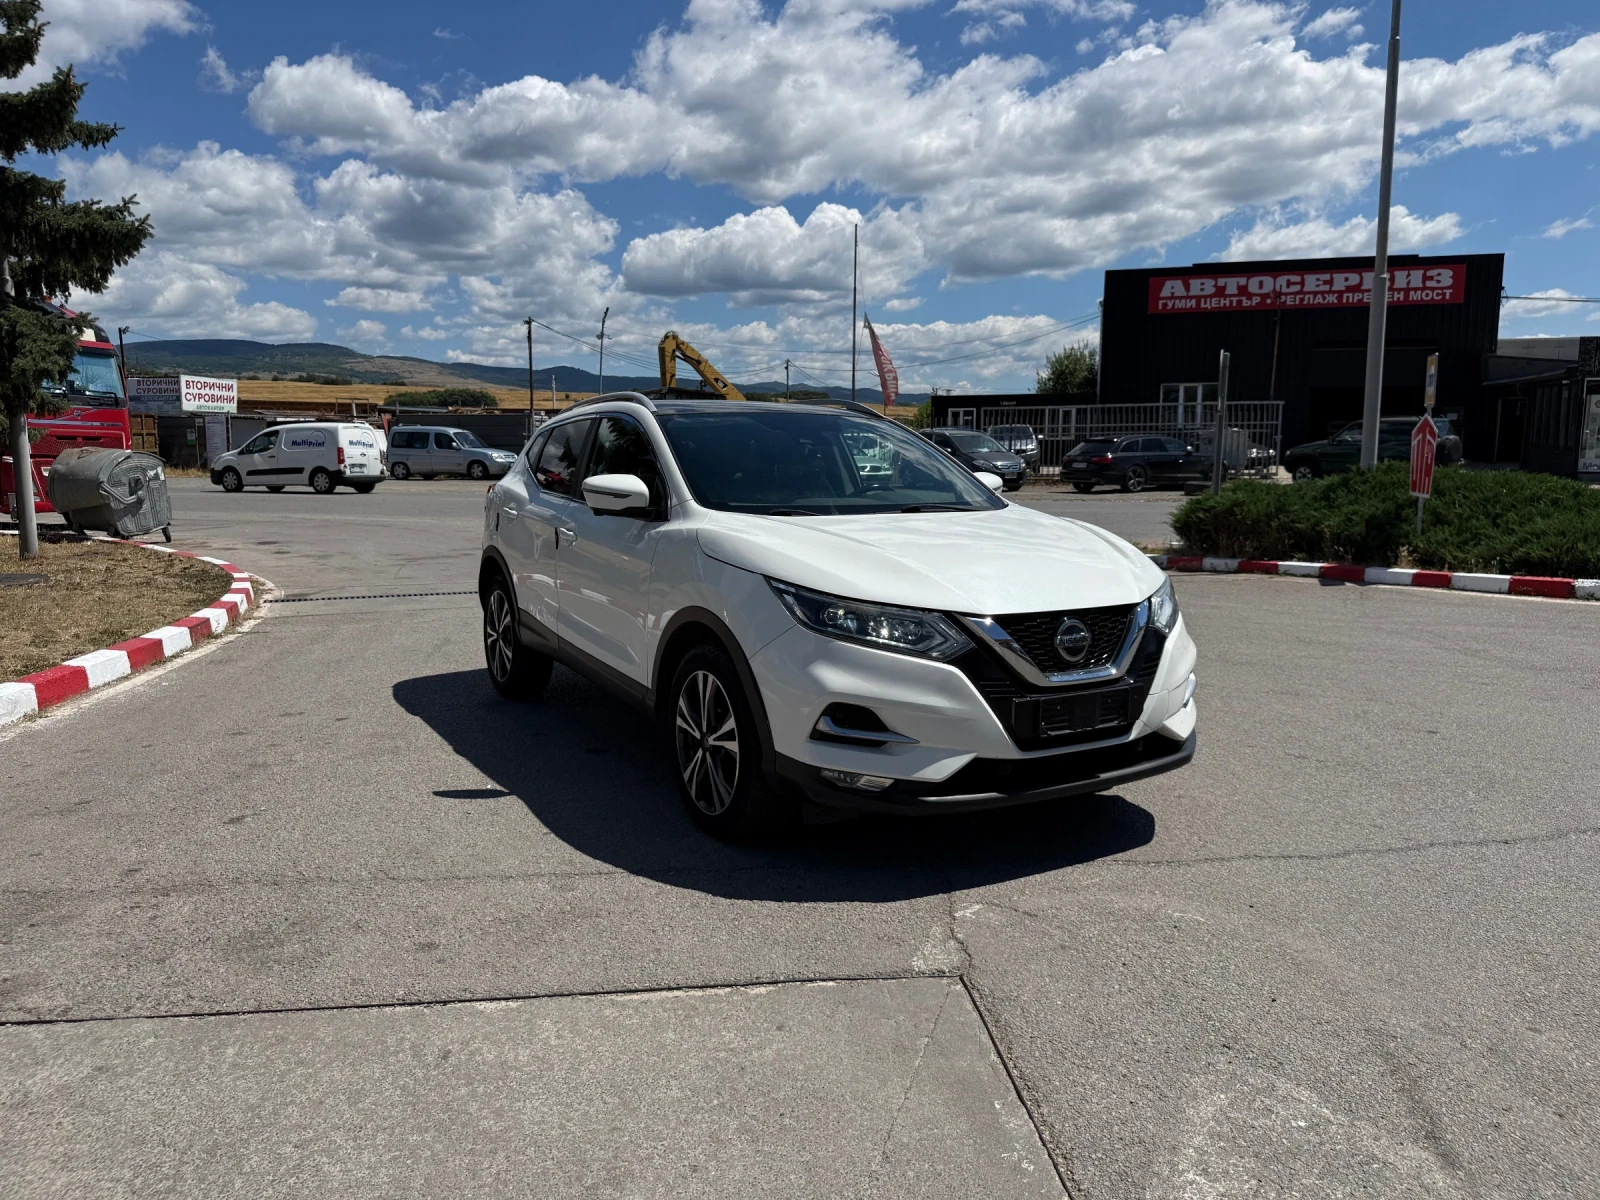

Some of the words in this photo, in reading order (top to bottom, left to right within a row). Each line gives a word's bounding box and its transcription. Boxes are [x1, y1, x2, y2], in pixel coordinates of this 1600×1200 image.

[1158, 298, 1196, 310] ГУМИ
[1200, 296, 1261, 309] ЦЕНТЪР
[1277, 293, 1339, 306] РЕГЛАЖ
[1342, 291, 1404, 303] ПРЕЕН
[1409, 289, 1453, 301] МОСТ
[136, 379, 179, 387] ВТОРИЧНИ
[185, 379, 234, 393] ВТОРИЧНИ
[136, 387, 180, 395] СУРОВИНИ
[184, 392, 235, 405] СУРОВИНИ
[1059, 635, 1088, 646] NISSAN
